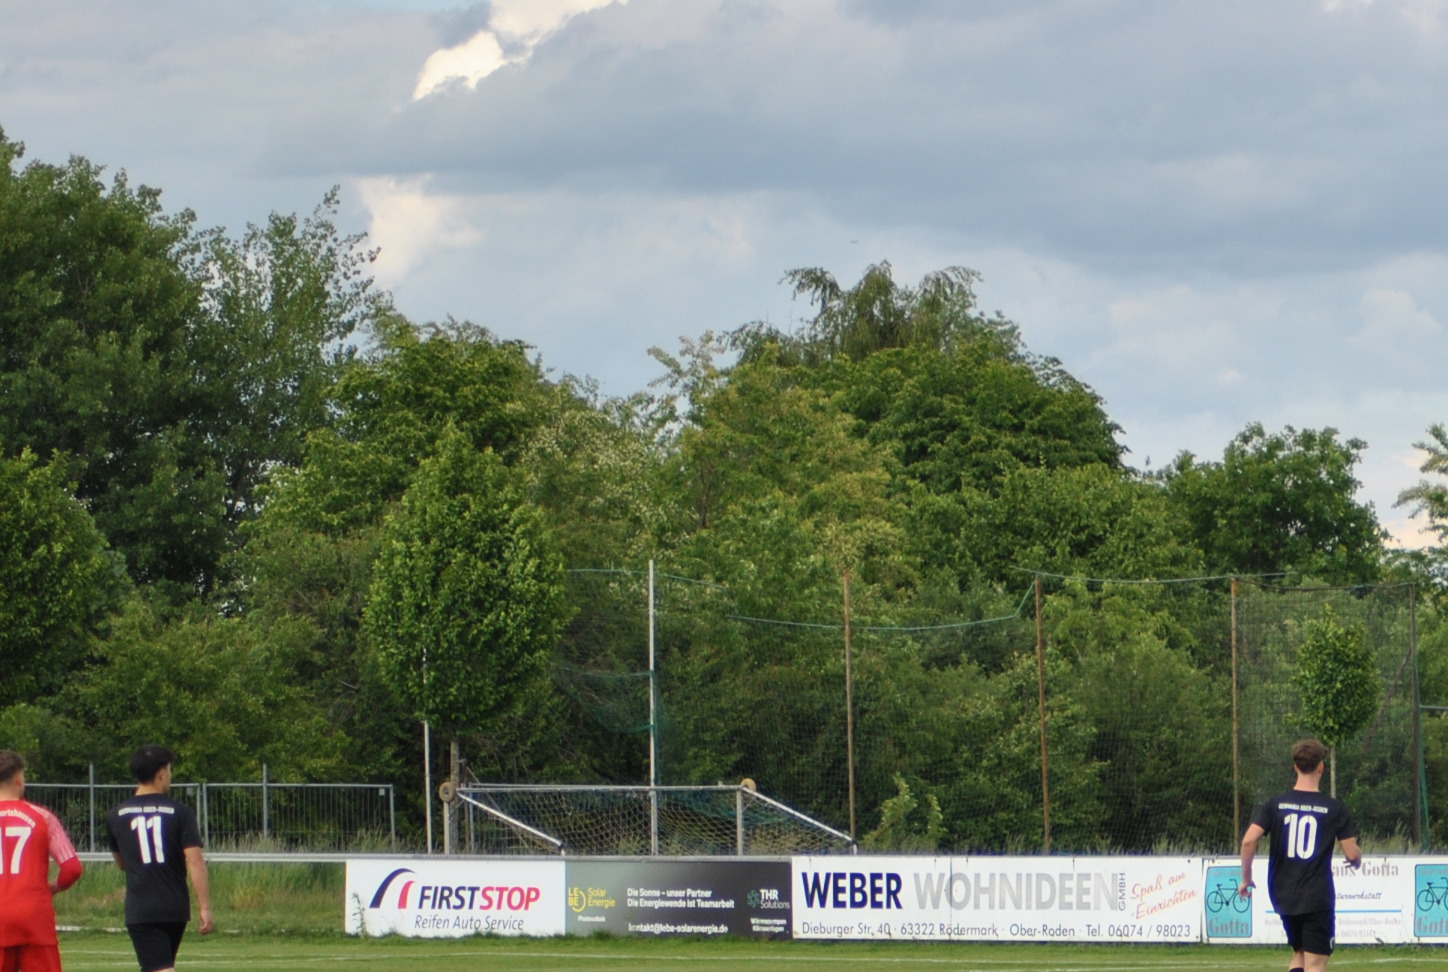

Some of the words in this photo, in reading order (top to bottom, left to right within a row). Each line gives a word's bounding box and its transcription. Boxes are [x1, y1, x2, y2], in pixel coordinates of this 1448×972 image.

[130, 816, 165, 864] 11
[1284, 814, 1318, 860] 10
[418, 886, 541, 910] FIRSTSTOP
[587, 888, 607, 897] Solar
[627, 888, 638, 897] Die
[639, 888, 660, 897] Sonne
[667, 889, 685, 897] unser
[686, 888, 712, 898] Partner
[759, 889, 779, 900] THR
[801, 872, 903, 909] WEBER
[913, 872, 1118, 911] WOHNIDEEN
[1118, 872, 1126, 911] GMBH
[587, 898, 616, 909] Energie
[627, 899, 638, 907] Die
[639, 899, 685, 909] Energiewende
[687, 899, 695, 907] ist
[697, 899, 735, 909] Teamarbeit
[760, 900, 790, 910] Solutions
[1135, 888, 1197, 920] Einrichten
[414, 915, 449, 929] Reifen
[452, 915, 482, 930] Auto
[485, 915, 524, 930] Service
[628, 923, 728, 934] kontakt@lebe-solarenergie.de
[802, 922, 854, 937] Dieburger
[877, 923, 890, 935] 40
[900, 923, 935, 936] 63322
[940, 923, 998, 936] Rödermark
[1010, 923, 1075, 937] Ober-Roden
[1086, 924, 1103, 937] Tel.
[1108, 924, 1143, 937] 06074
[1156, 925, 1190, 937] 98023
